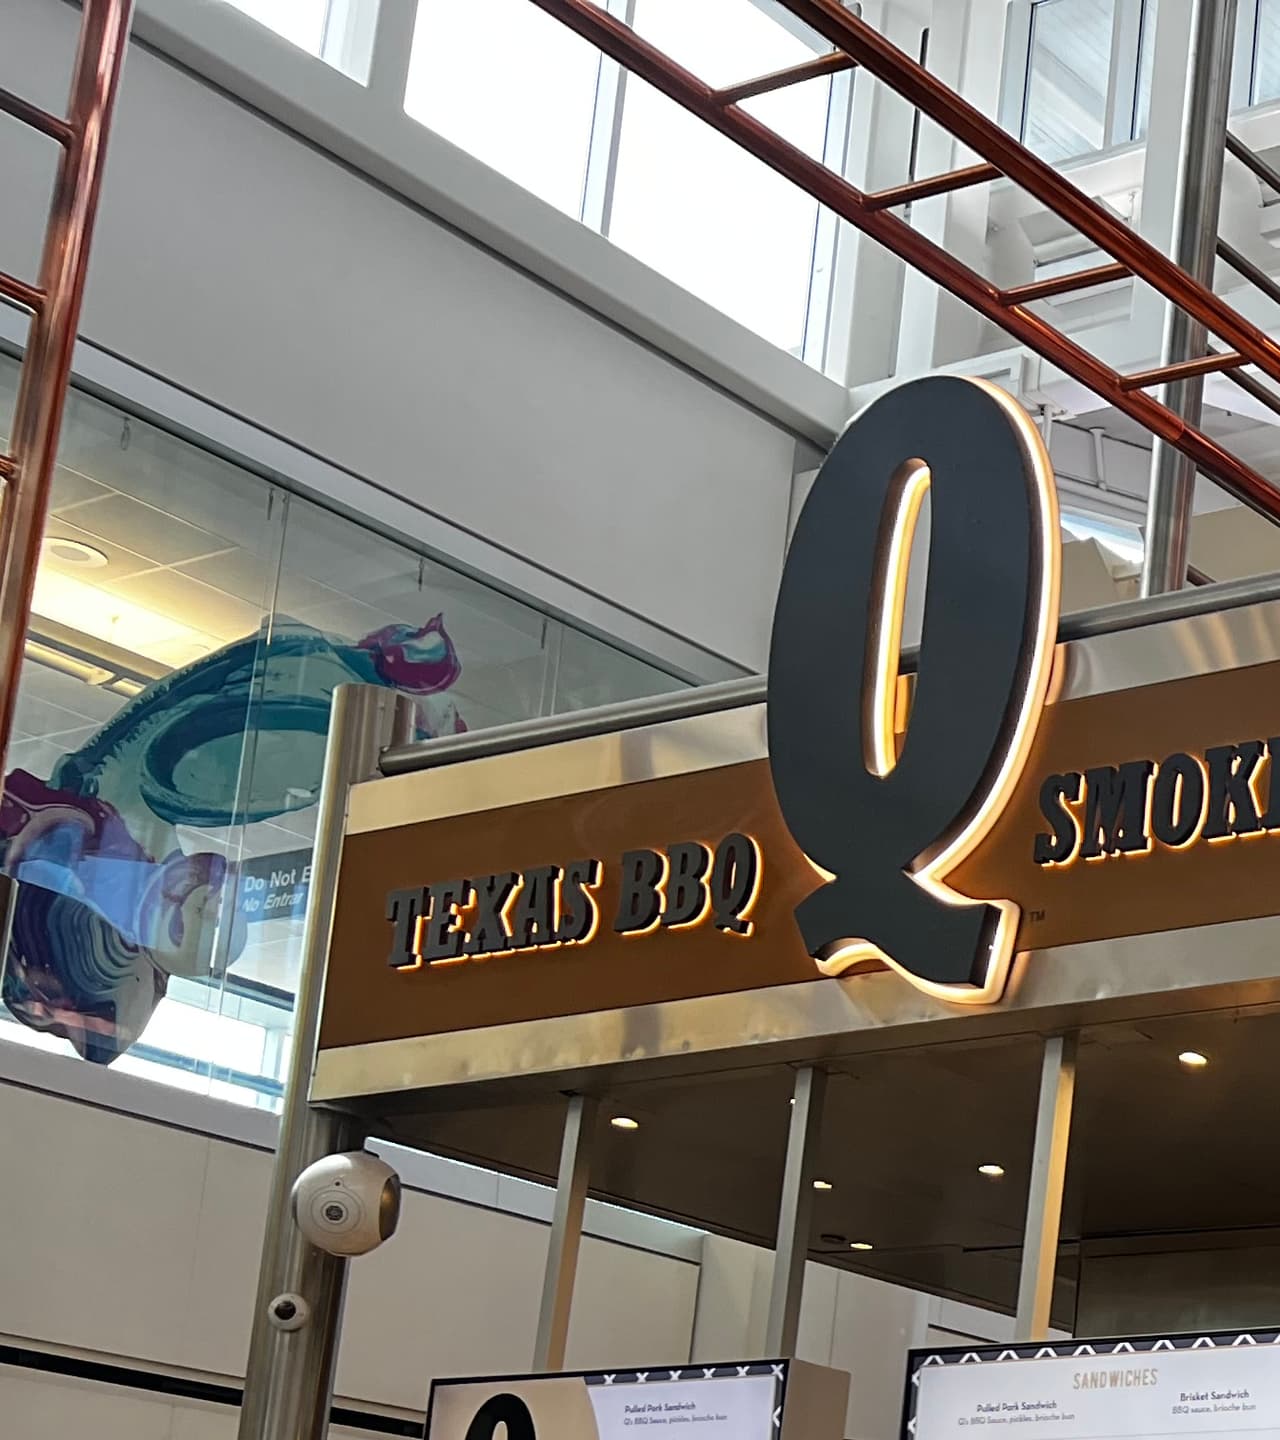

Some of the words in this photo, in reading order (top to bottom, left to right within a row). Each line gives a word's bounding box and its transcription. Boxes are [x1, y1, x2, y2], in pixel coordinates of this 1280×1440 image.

[767, 375, 1052, 1000] Q
[244, 876, 264, 893] Do
[270, 869, 296, 888] Not
[242, 897, 260, 912] No
[385, 858, 601, 970] TEXAS
[613, 831, 762, 938] BBQ
[1073, 1368, 1159, 1390] SANDWICHES
[1180, 1392, 1209, 1401] Brisket
[1211, 1390, 1249, 1400] Sandwich
[624, 1404, 646, 1414] Pulled
[664, 1401, 696, 1411] Sandwich
[976, 1402, 1000, 1412] Pulled
[1021, 1400, 1057, 1410] Sandwich
[1172, 1405, 1189, 1414] BBQ
